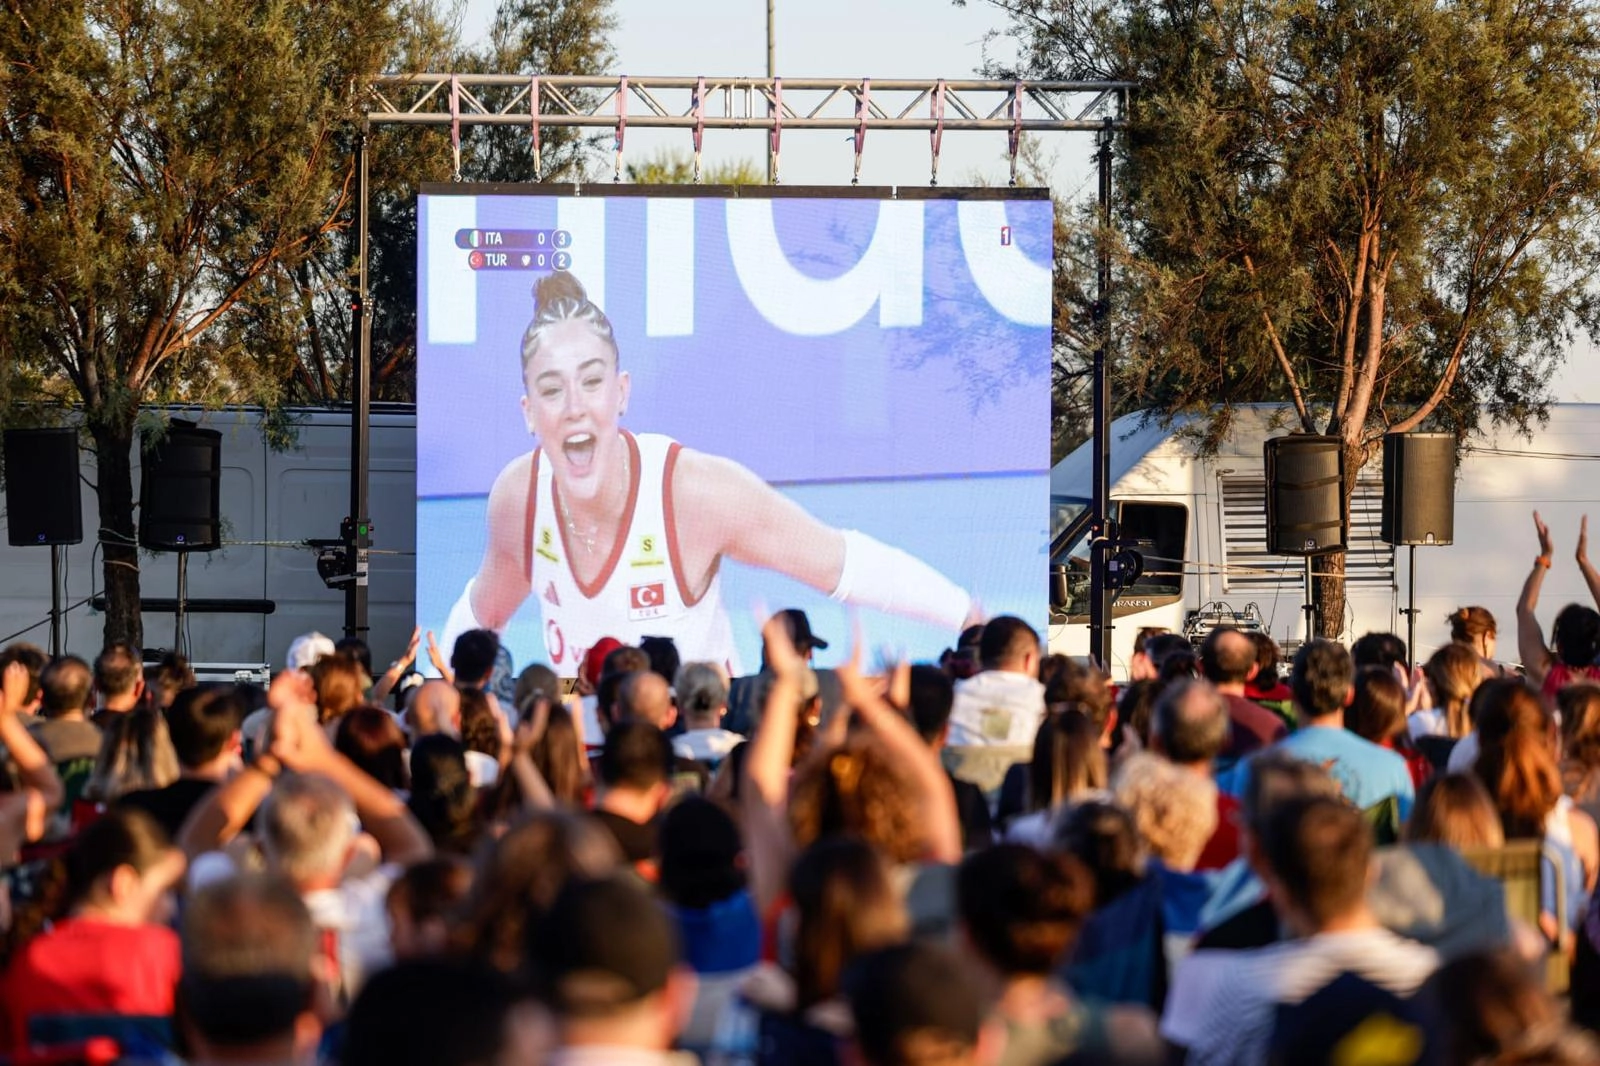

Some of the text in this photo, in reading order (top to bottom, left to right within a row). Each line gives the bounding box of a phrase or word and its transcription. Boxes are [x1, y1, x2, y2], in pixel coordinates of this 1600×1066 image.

[485, 232, 567, 246] ITA 0 3
[485, 253, 566, 266] TUR 0 2
